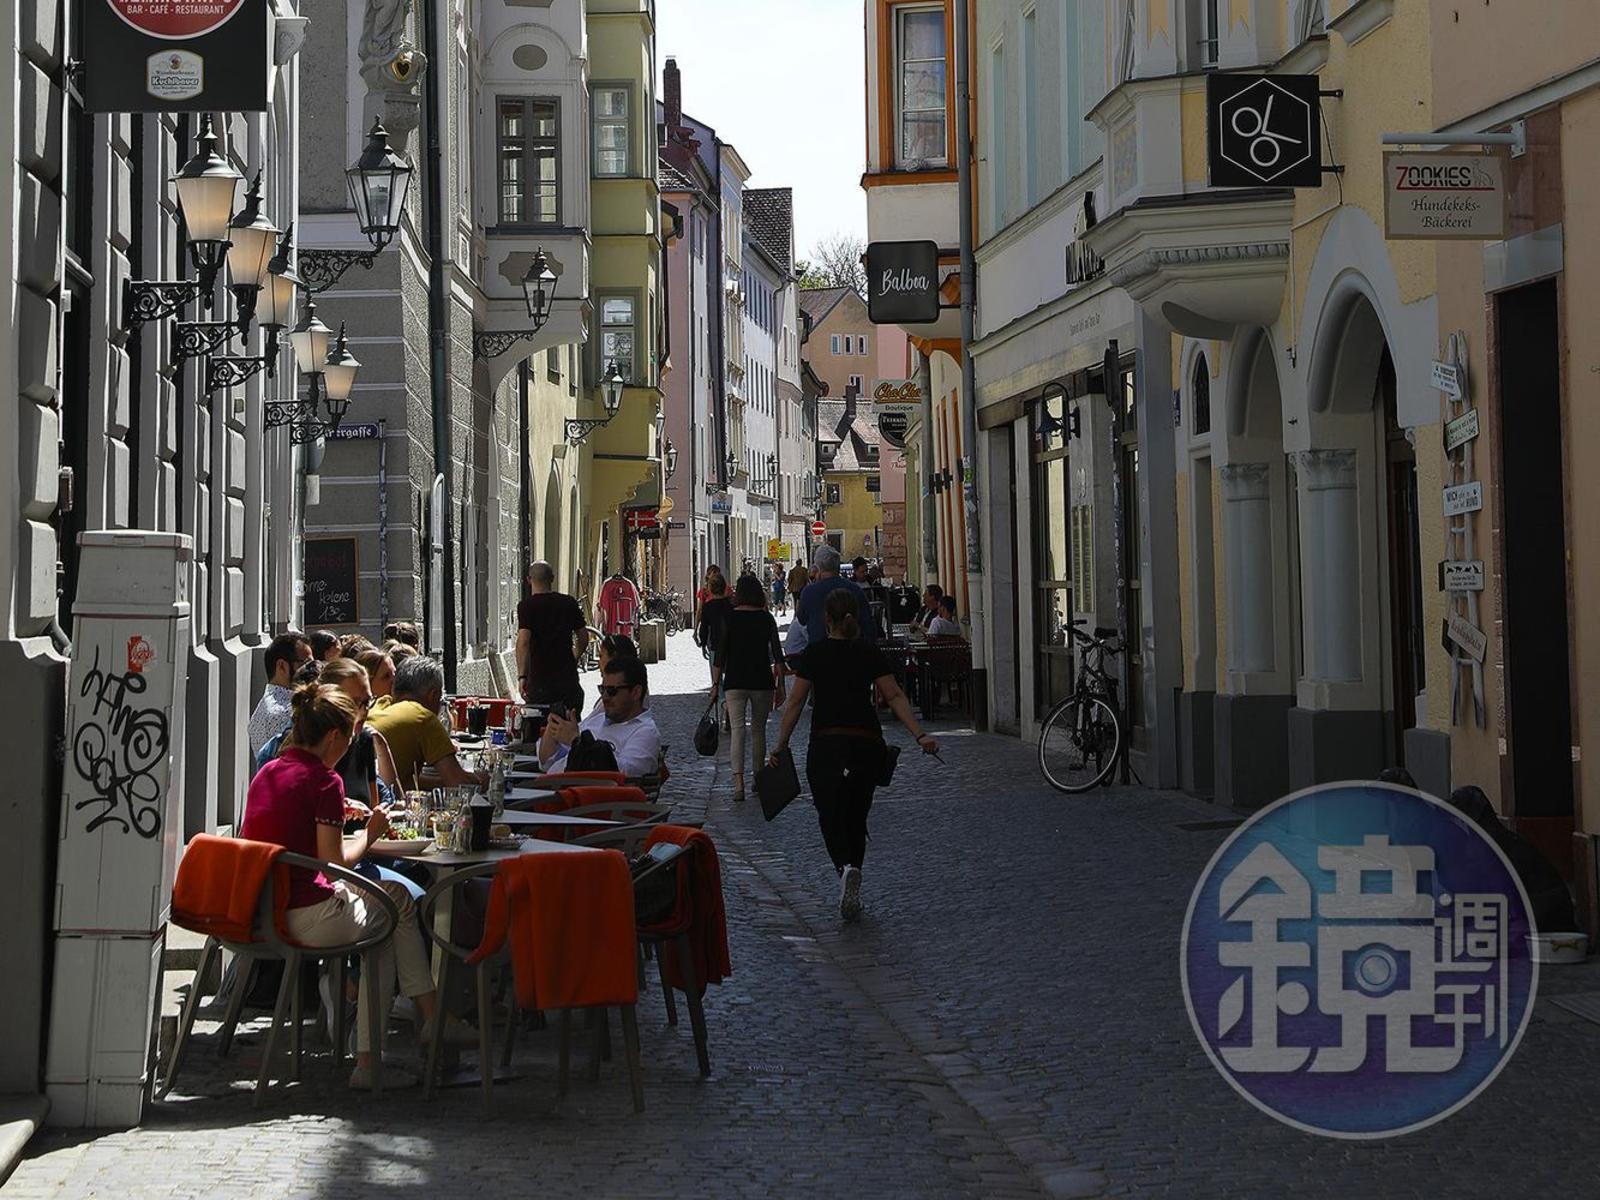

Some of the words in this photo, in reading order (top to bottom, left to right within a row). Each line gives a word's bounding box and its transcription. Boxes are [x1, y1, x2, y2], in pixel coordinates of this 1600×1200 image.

[127, 4, 143, 14] BAR
[149, 3, 169, 14] CAFÉ
[175, 4, 224, 14] RESTAURANT
[1396, 166, 1471, 190] ZOOKIES
[1422, 214, 1473, 228] Bäckerei
[879, 268, 929, 296] Balboa
